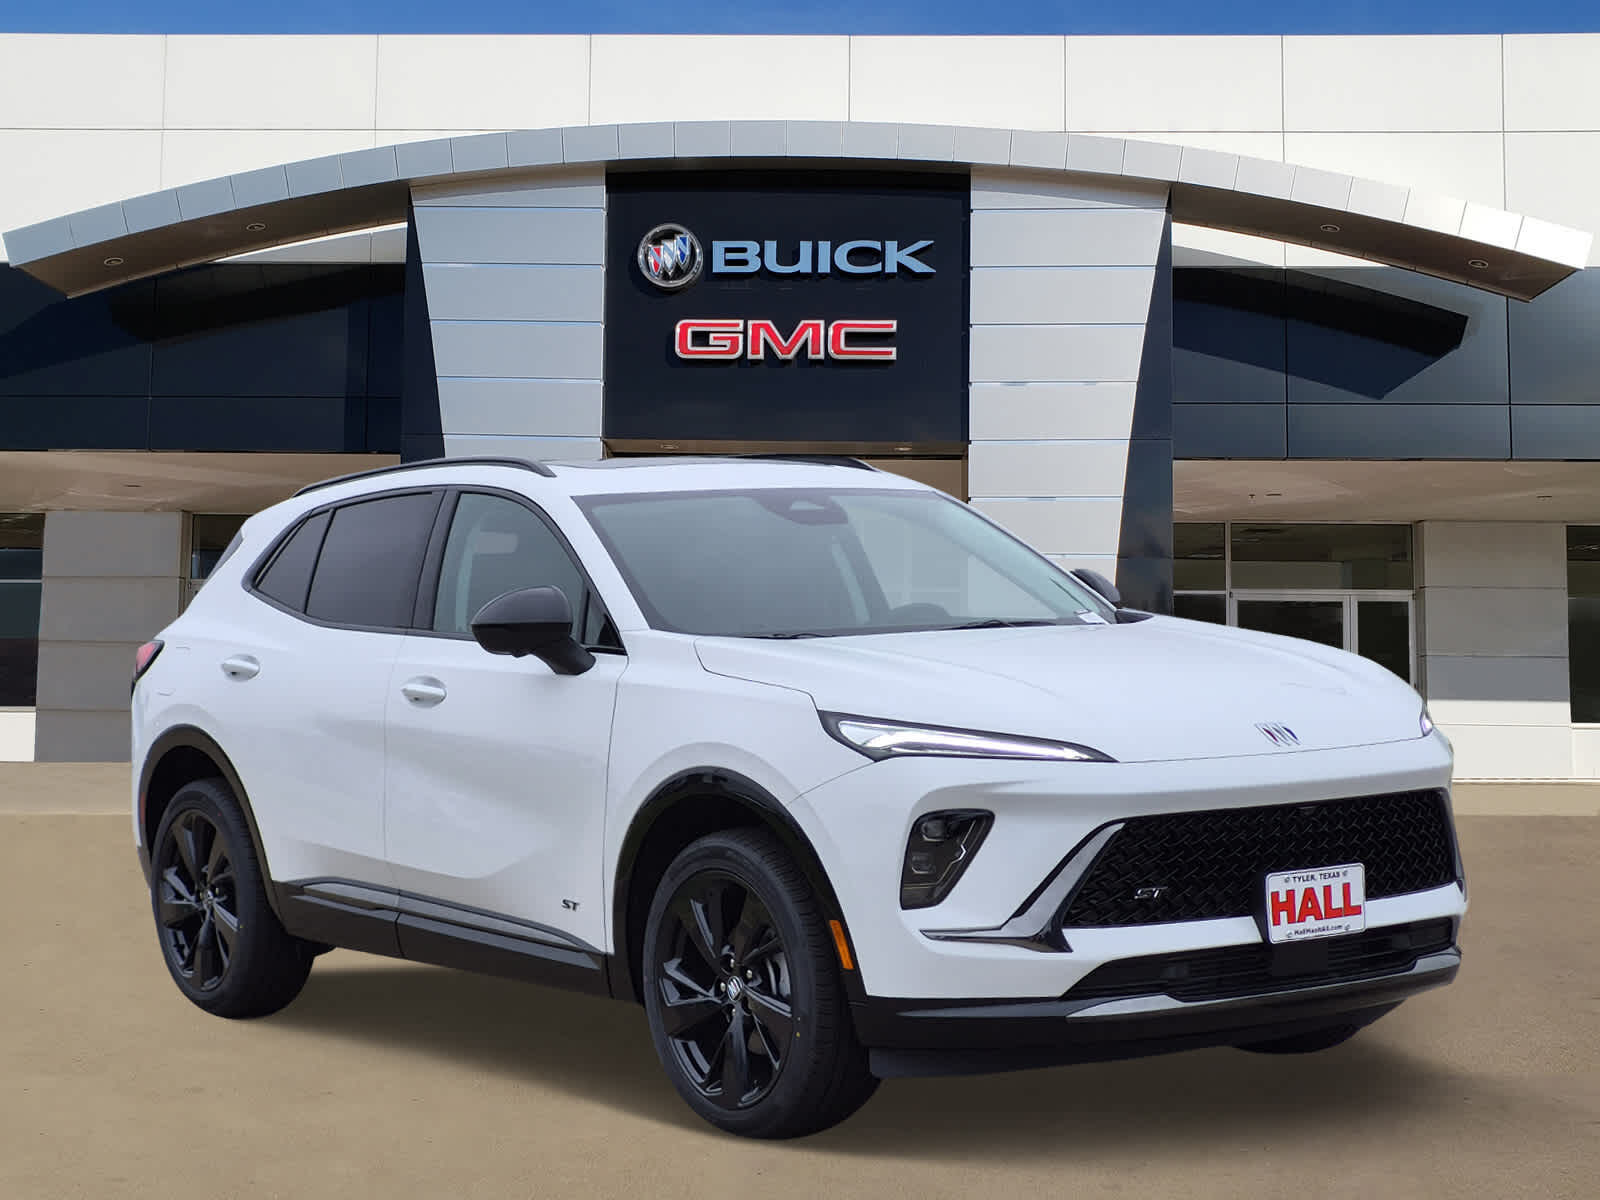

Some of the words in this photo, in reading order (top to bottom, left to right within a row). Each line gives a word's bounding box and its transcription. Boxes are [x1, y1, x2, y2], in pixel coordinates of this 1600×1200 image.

[711, 240, 937, 273] BUICK
[675, 319, 898, 360] GMC
[1319, 871, 1341, 880] TEXAS
[1134, 886, 1169, 899] ST
[1271, 882, 1363, 926] HALL
[562, 899, 581, 912] ST
